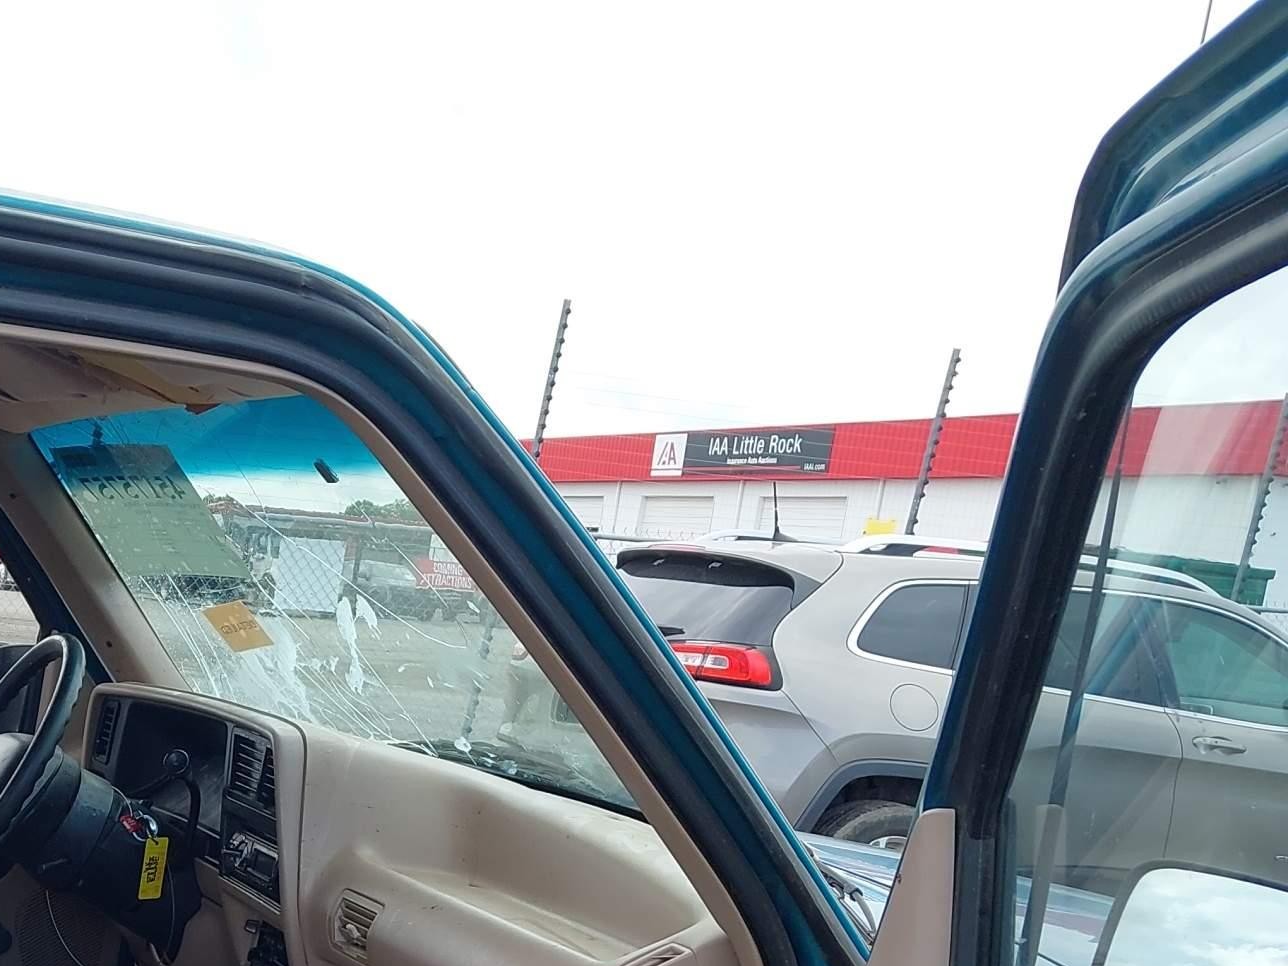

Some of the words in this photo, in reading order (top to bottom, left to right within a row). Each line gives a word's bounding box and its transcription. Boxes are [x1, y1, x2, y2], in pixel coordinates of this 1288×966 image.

[708, 437, 729, 456] IAA
[732, 436, 765, 455] Little
[768, 433, 803, 454] Rock
[433, 562, 463, 576] COMING
